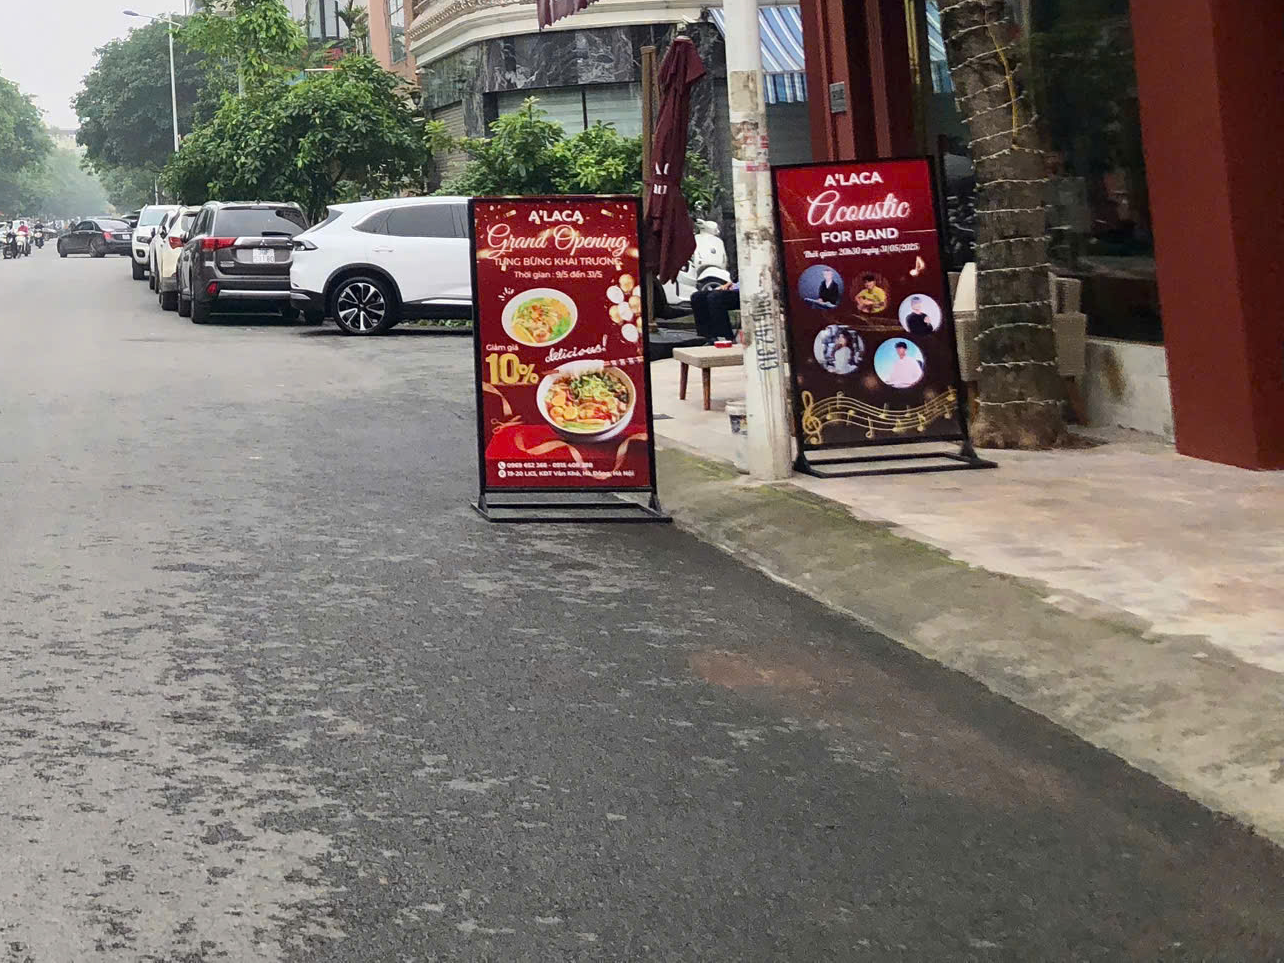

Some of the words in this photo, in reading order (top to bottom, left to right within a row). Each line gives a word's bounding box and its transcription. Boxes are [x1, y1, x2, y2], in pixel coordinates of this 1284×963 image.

[824, 171, 884, 187] A'LACA
[528, 209, 584, 223] A'LACA
[806, 190, 911, 226] Acoustic
[487, 223, 549, 259] Grand
[553, 224, 629, 257] Opening
[821, 230, 852, 244] FOR
[855, 227, 899, 241] BAND
[524, 255, 552, 266] BỪNG
[554, 257, 578, 266] KHAI
[580, 256, 622, 267] TRƯƠNG
[514, 270, 532, 278] Thời
[532, 271, 551, 280] gian
[555, 270, 568, 278] 9/5
[569, 270, 586, 278] đến
[587, 270, 603, 278] 31/5
[507, 343, 519, 352] giá
[545, 334, 608, 363] delicious!
[485, 353, 540, 385] 10%
